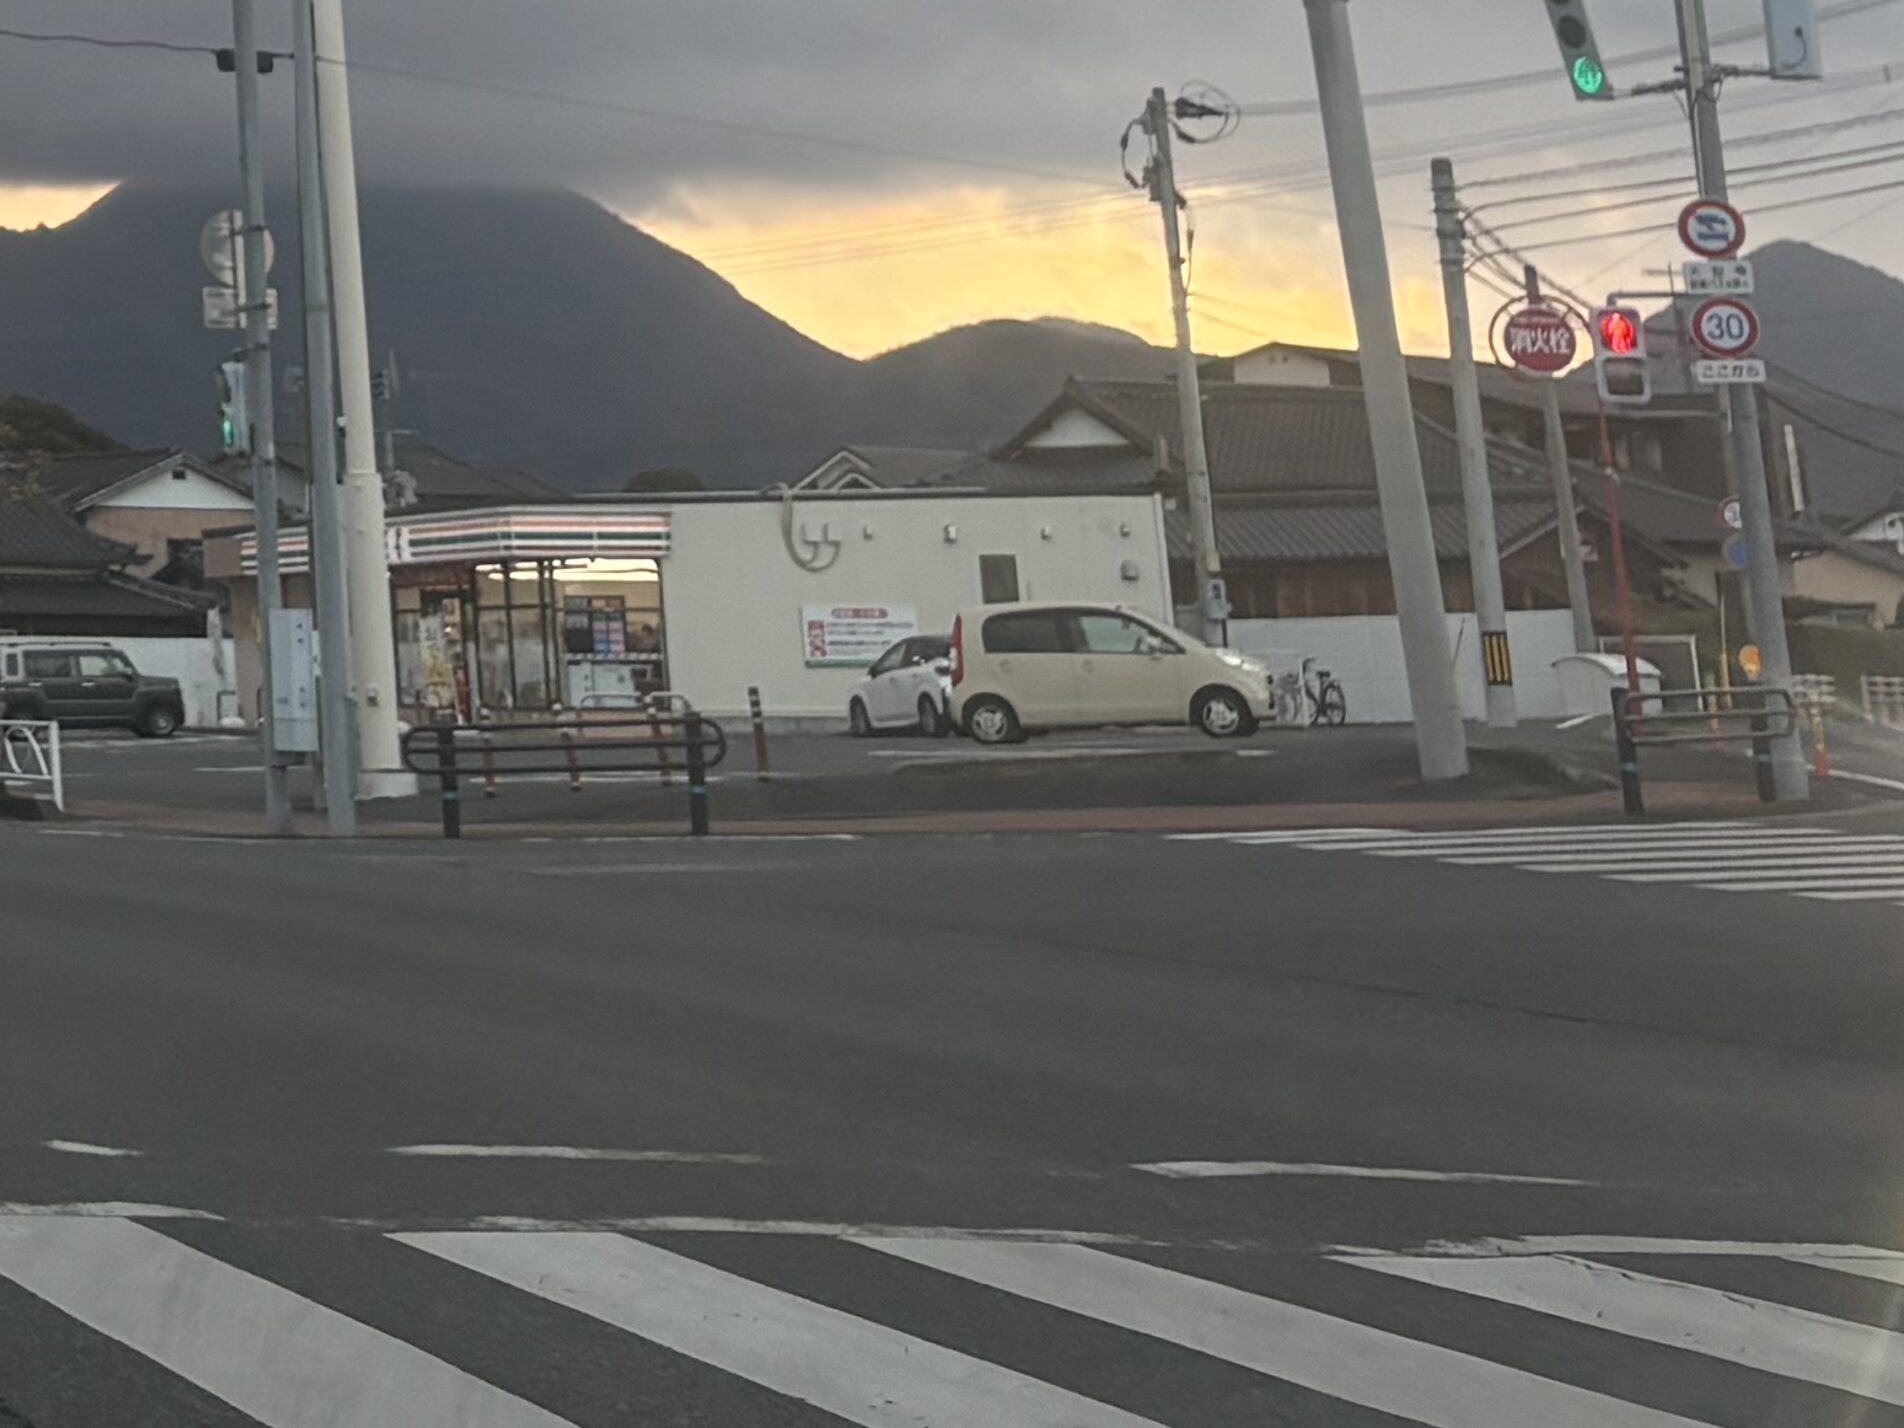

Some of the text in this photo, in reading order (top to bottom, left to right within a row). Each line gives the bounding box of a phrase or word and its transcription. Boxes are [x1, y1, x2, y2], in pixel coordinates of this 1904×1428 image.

[1509, 327, 1571, 354] 消火栓
[1707, 313, 1745, 341] 30
